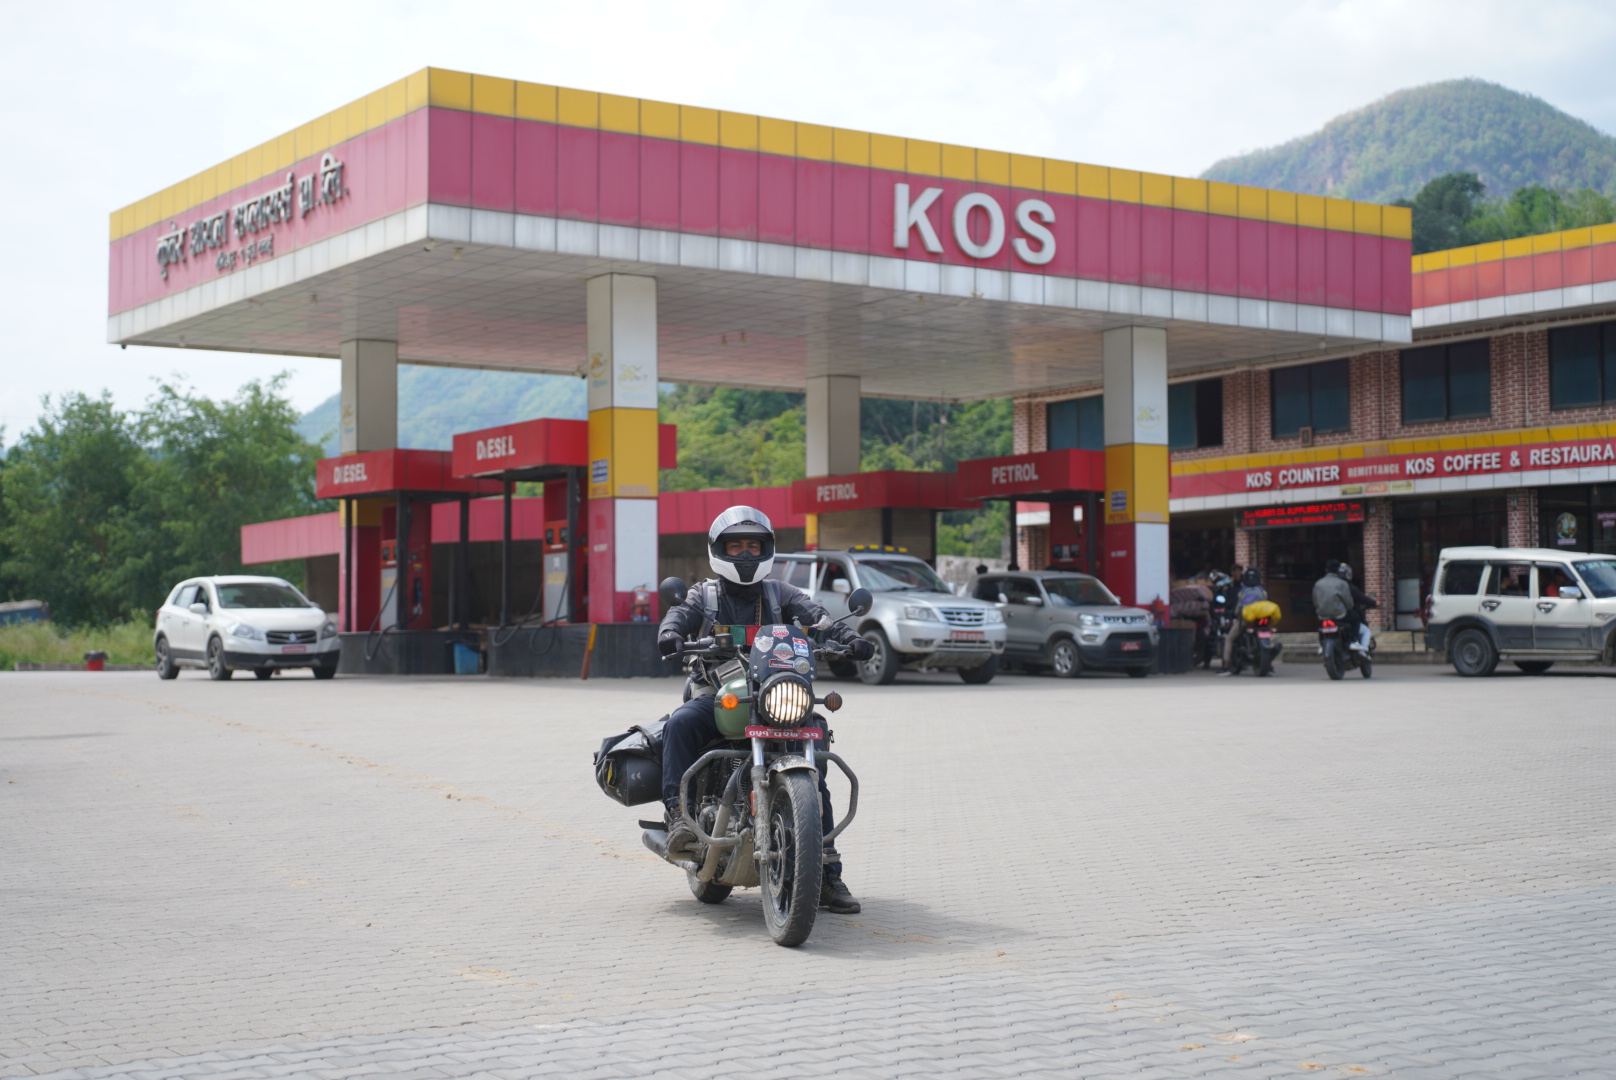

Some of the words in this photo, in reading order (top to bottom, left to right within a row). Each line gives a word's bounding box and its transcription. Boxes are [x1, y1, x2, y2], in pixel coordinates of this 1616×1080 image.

[893, 182, 1056, 265] KOS
[992, 463, 1039, 484] PETROL
[1405, 457, 1435, 476] KOS
[1443, 451, 1501, 473] COFFEE
[1509, 450, 1521, 468] &
[1246, 472, 1272, 488] KOS
[1279, 466, 1340, 485] COUNTER
[817, 483, 858, 502] PETROL
